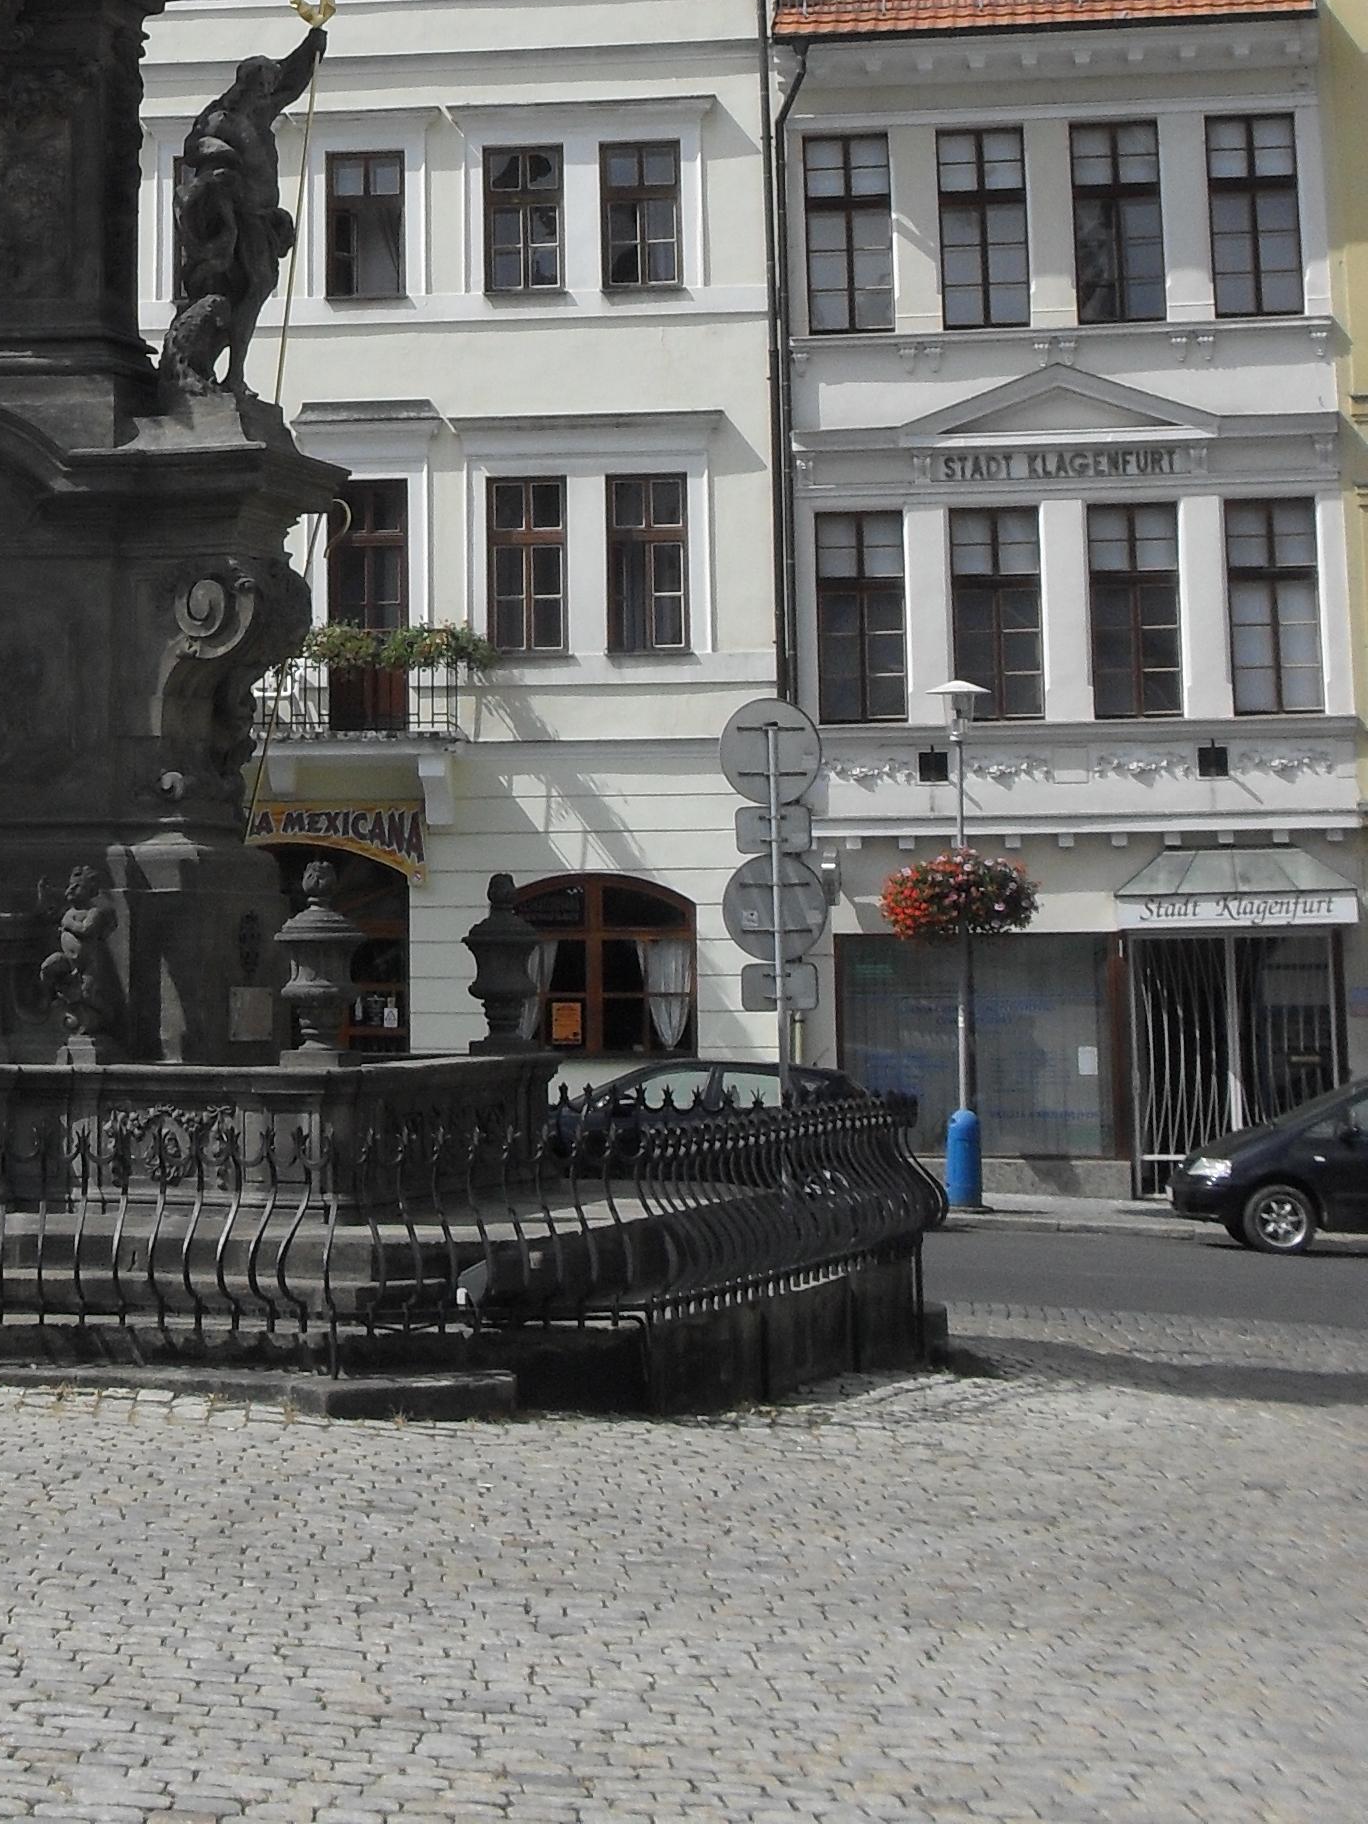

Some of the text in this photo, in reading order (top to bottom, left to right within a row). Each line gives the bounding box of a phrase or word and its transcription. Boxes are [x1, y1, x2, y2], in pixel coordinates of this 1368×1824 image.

[943, 449, 1177, 479] STADT KLAGENFURT
[282, 808, 425, 864] MEXICANA
[1139, 894, 1334, 925] Stadt Klagenfurt
